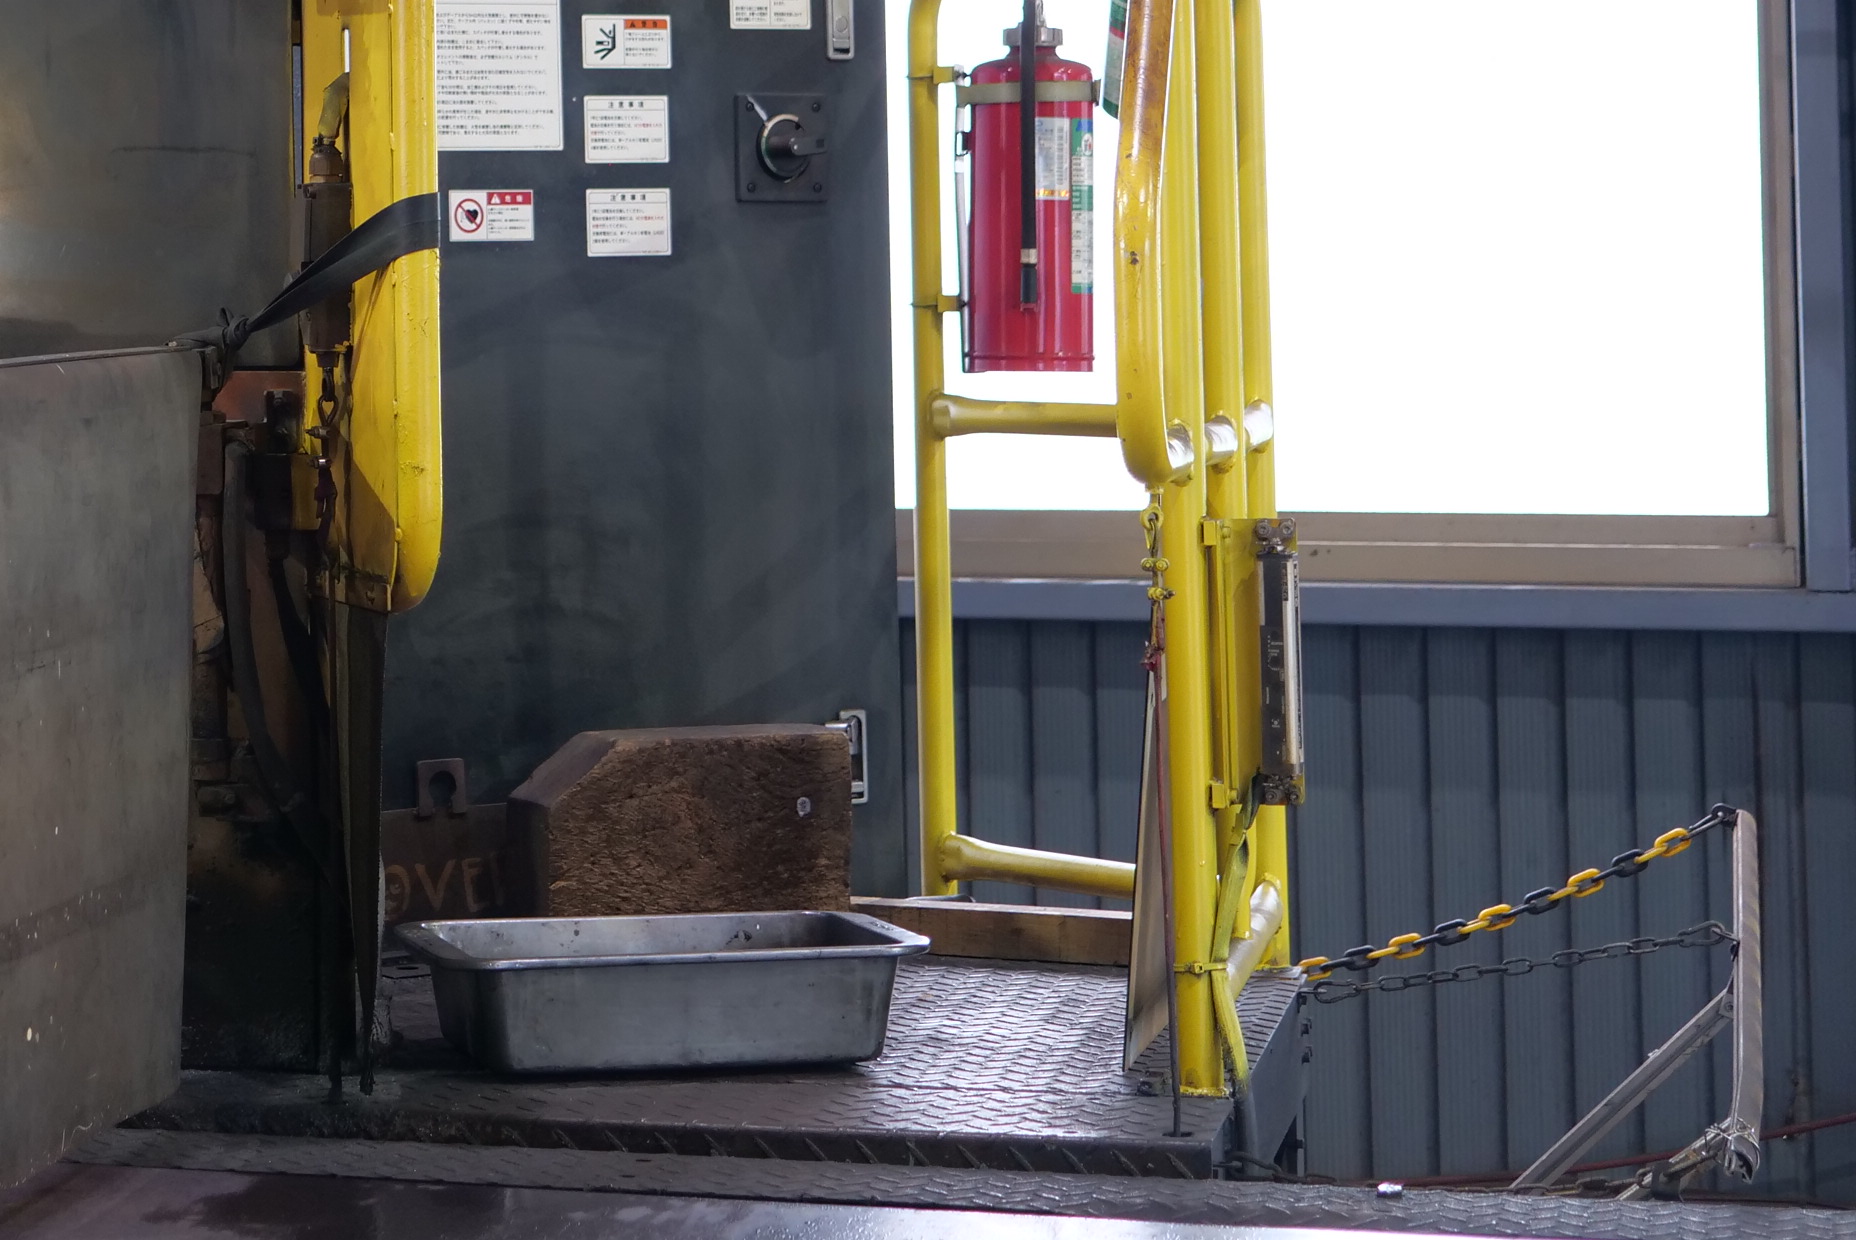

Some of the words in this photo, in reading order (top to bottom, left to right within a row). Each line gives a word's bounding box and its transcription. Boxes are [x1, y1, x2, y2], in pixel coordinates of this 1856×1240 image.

[608, 101, 644, 109] 注意事項
[610, 194, 646, 202] 注意事項
